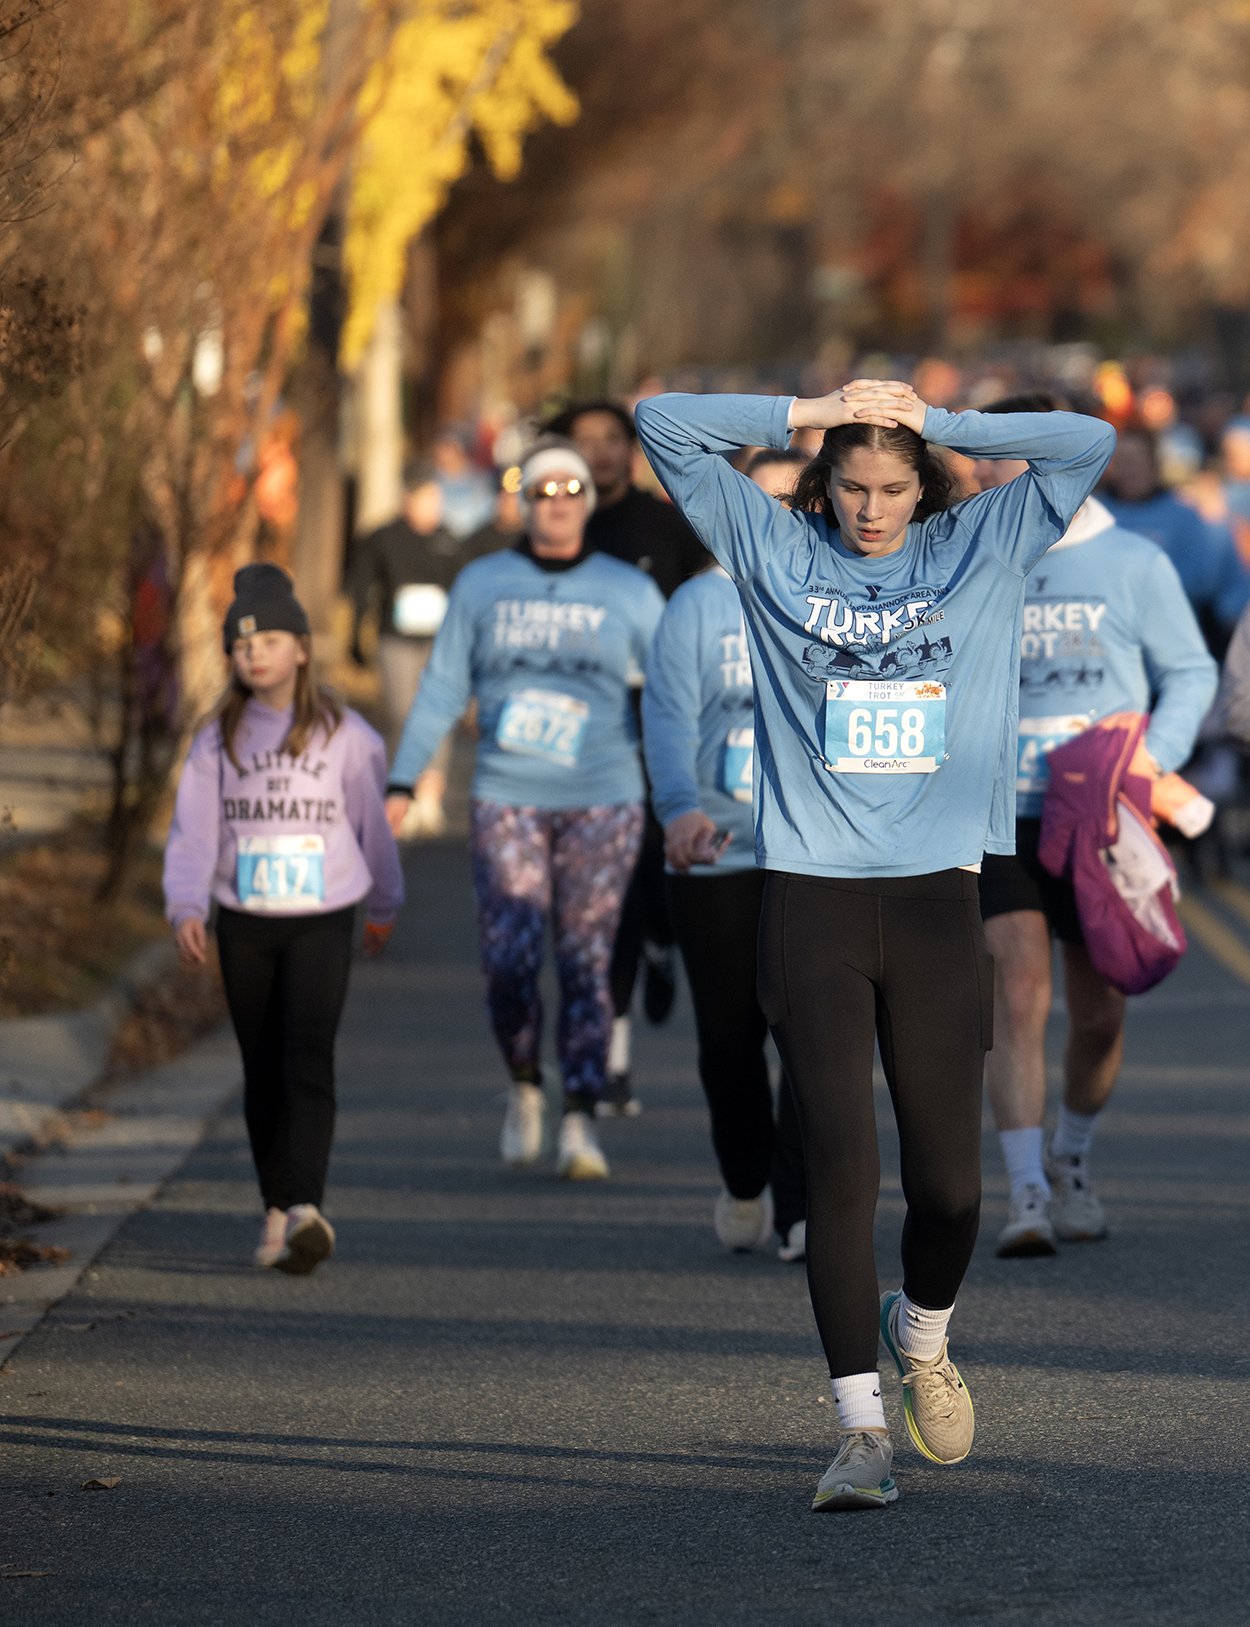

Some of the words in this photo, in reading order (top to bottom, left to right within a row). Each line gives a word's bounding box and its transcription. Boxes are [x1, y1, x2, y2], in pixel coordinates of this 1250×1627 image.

[825, 587, 851, 605] ANNUAL
[850, 595, 910, 611] APPAHANNOCK
[910, 588, 932, 600] AREA
[494, 600, 607, 632] TURKEY
[868, 682, 905, 691] TURKEY
[868, 691, 892, 700] TROT
[848, 708, 925, 757] 658
[252, 751, 327, 780] LITTLE
[863, 759, 908, 769] CleanArc
[223, 798, 337, 823] DRAMATIC
[252, 857, 310, 895] 417
